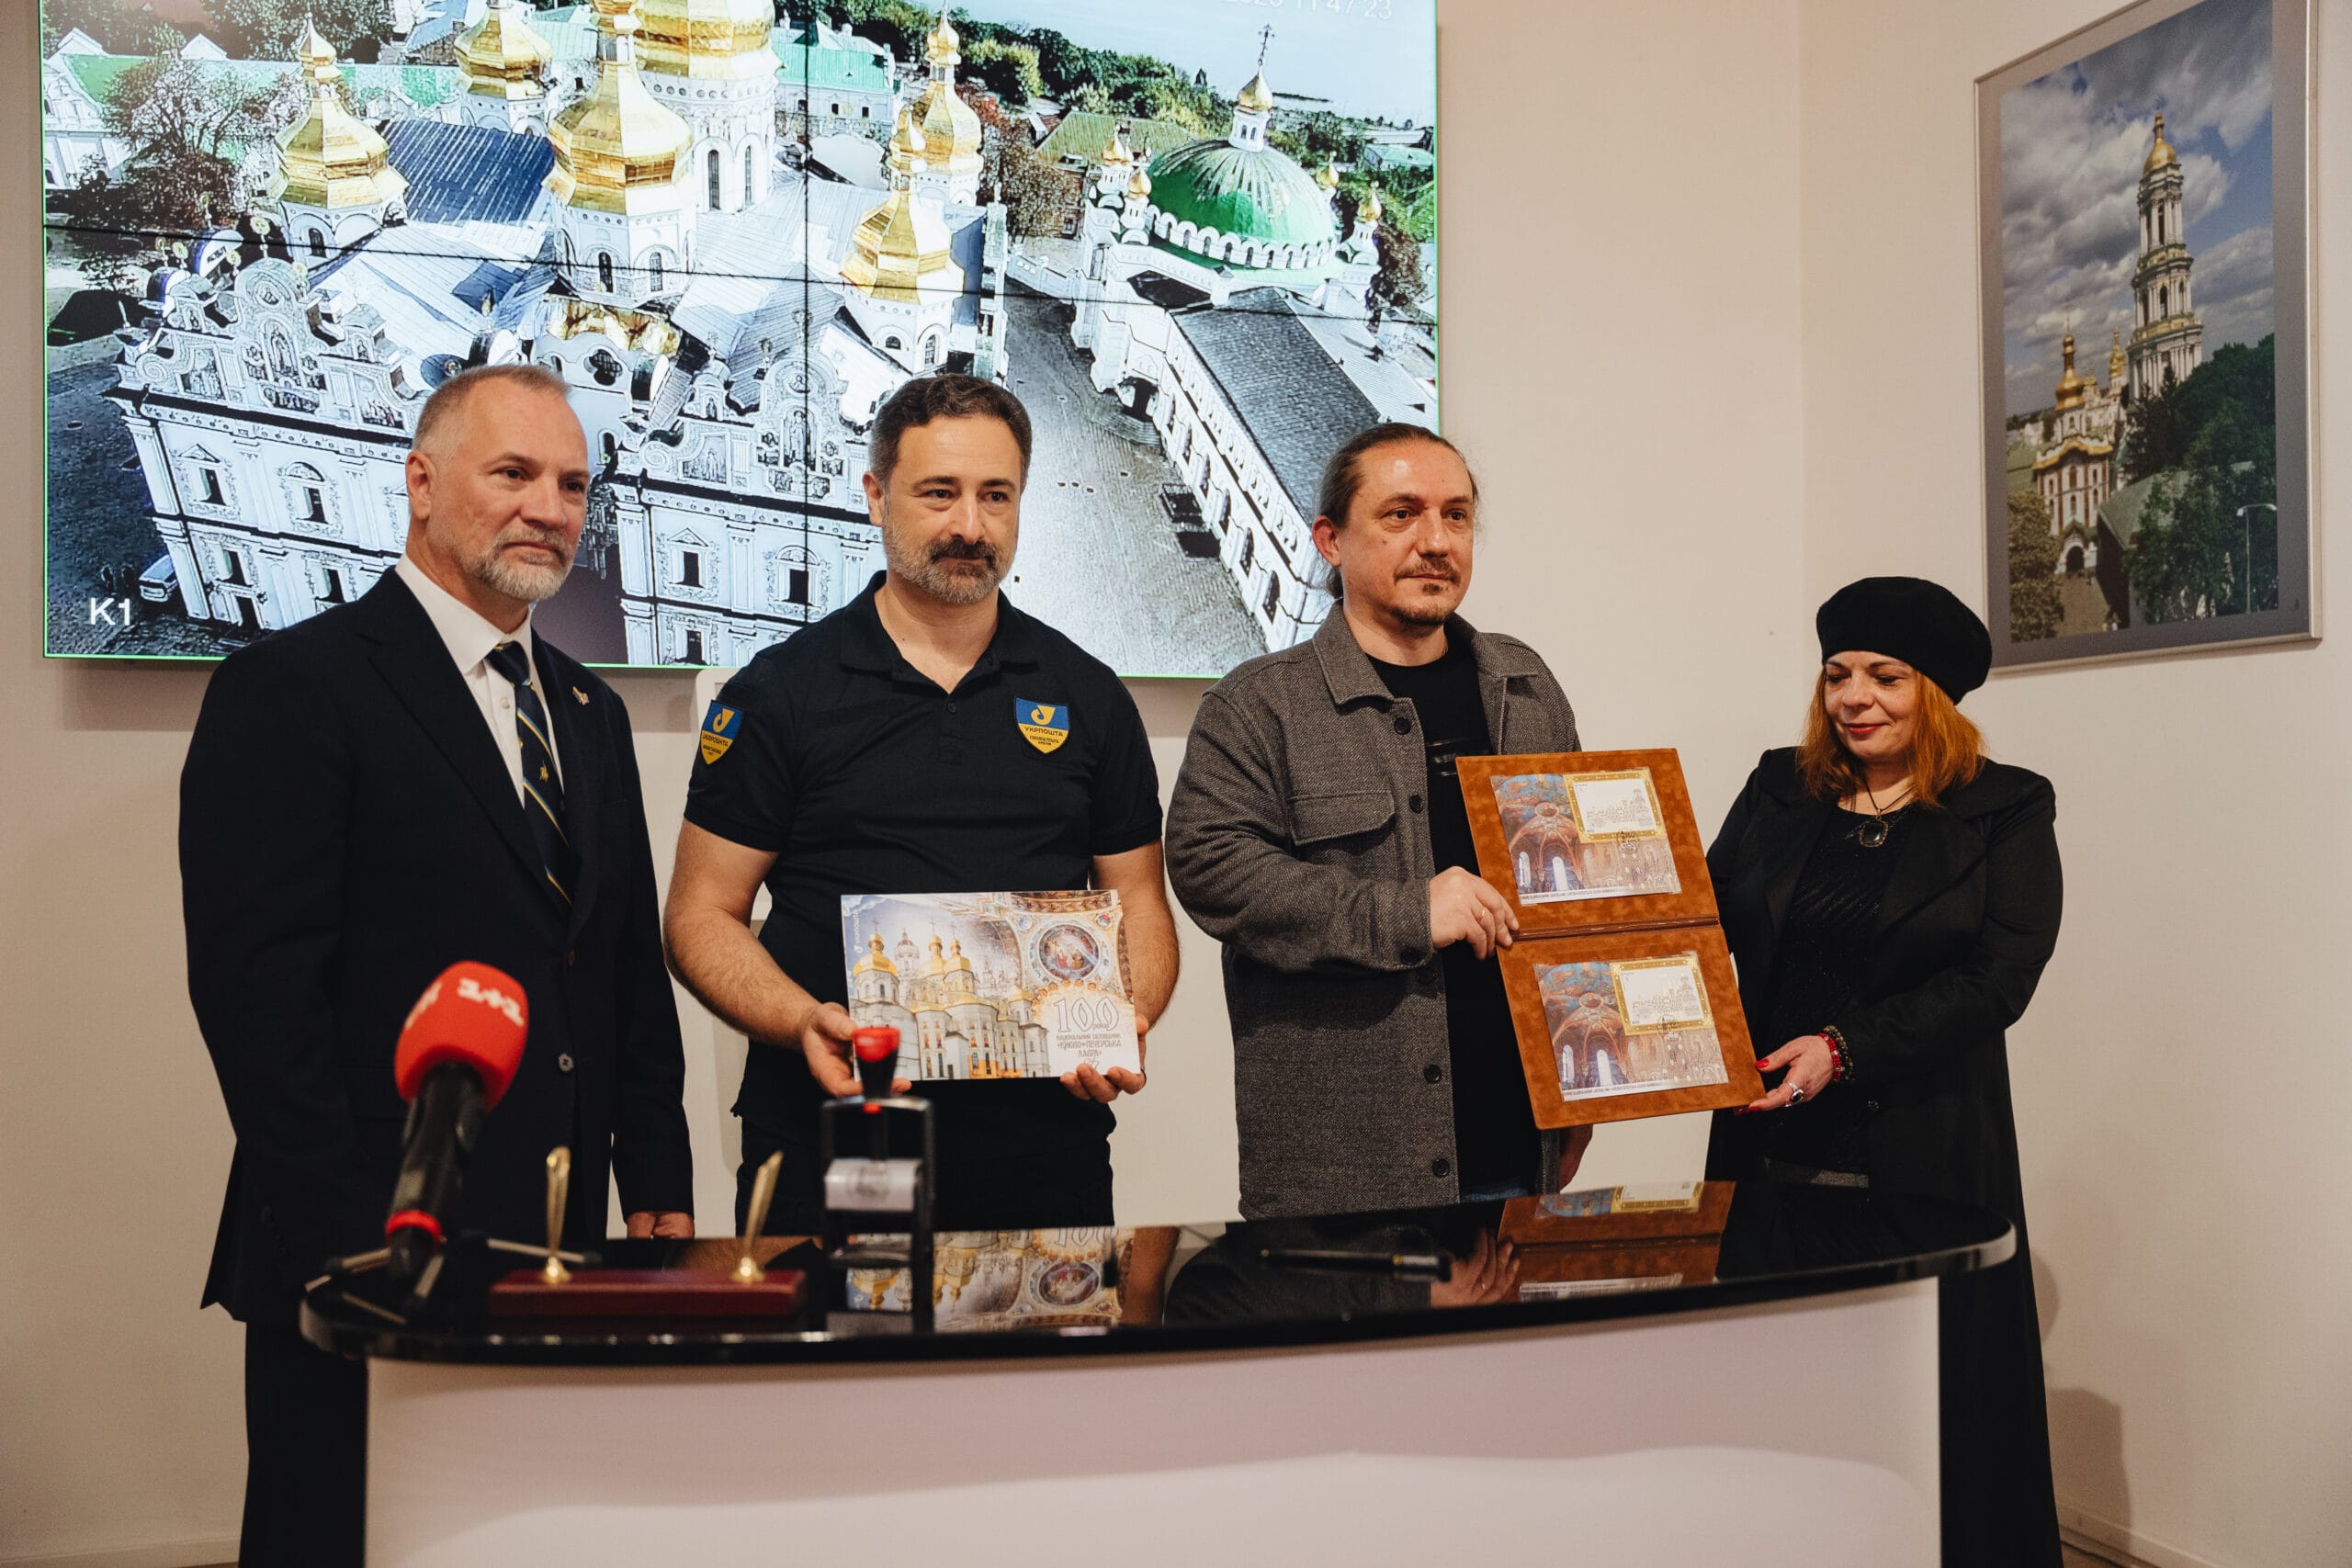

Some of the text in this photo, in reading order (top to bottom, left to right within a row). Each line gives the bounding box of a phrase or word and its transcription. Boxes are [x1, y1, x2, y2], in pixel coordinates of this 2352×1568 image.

[91, 597, 130, 626] K1
[1024, 727, 1063, 737] УКРПОШТА
[1053, 997, 1119, 1032] 100
